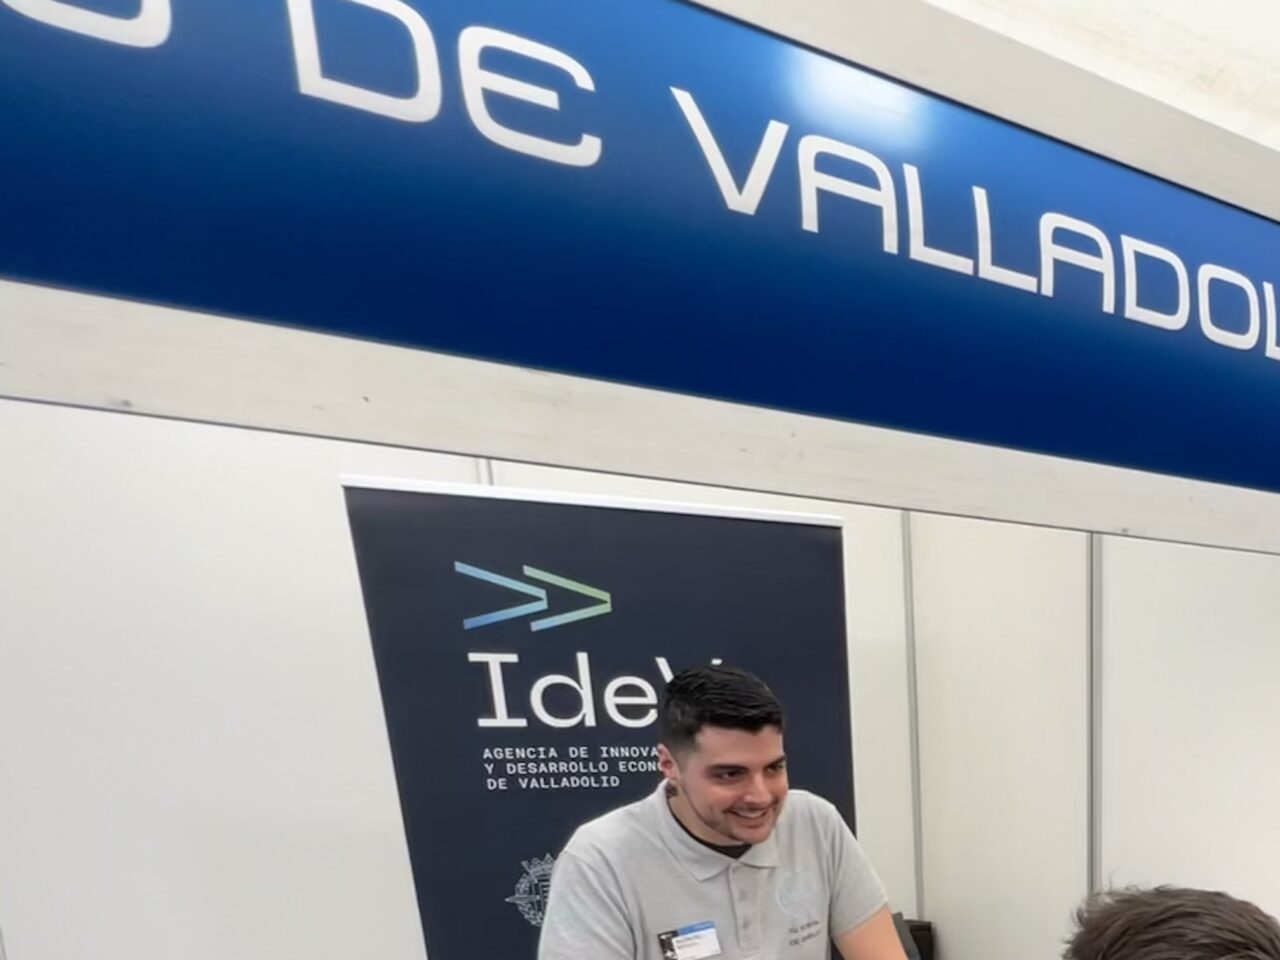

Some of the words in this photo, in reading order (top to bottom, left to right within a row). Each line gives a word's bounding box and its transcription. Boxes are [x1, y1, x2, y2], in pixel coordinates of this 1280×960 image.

[286, 0, 602, 167] DE
[467, 651, 722, 728] Ide
[482, 747, 558, 760] AGENCIA
[569, 746, 589, 758] DE
[600, 746, 660, 759] INNOVA
[484, 763, 495, 775] Y
[506, 762, 609, 775] DESARROLLO
[618, 761, 662, 772] ECON
[487, 778, 508, 790] DE
[518, 776, 620, 789] VALLADOLID
